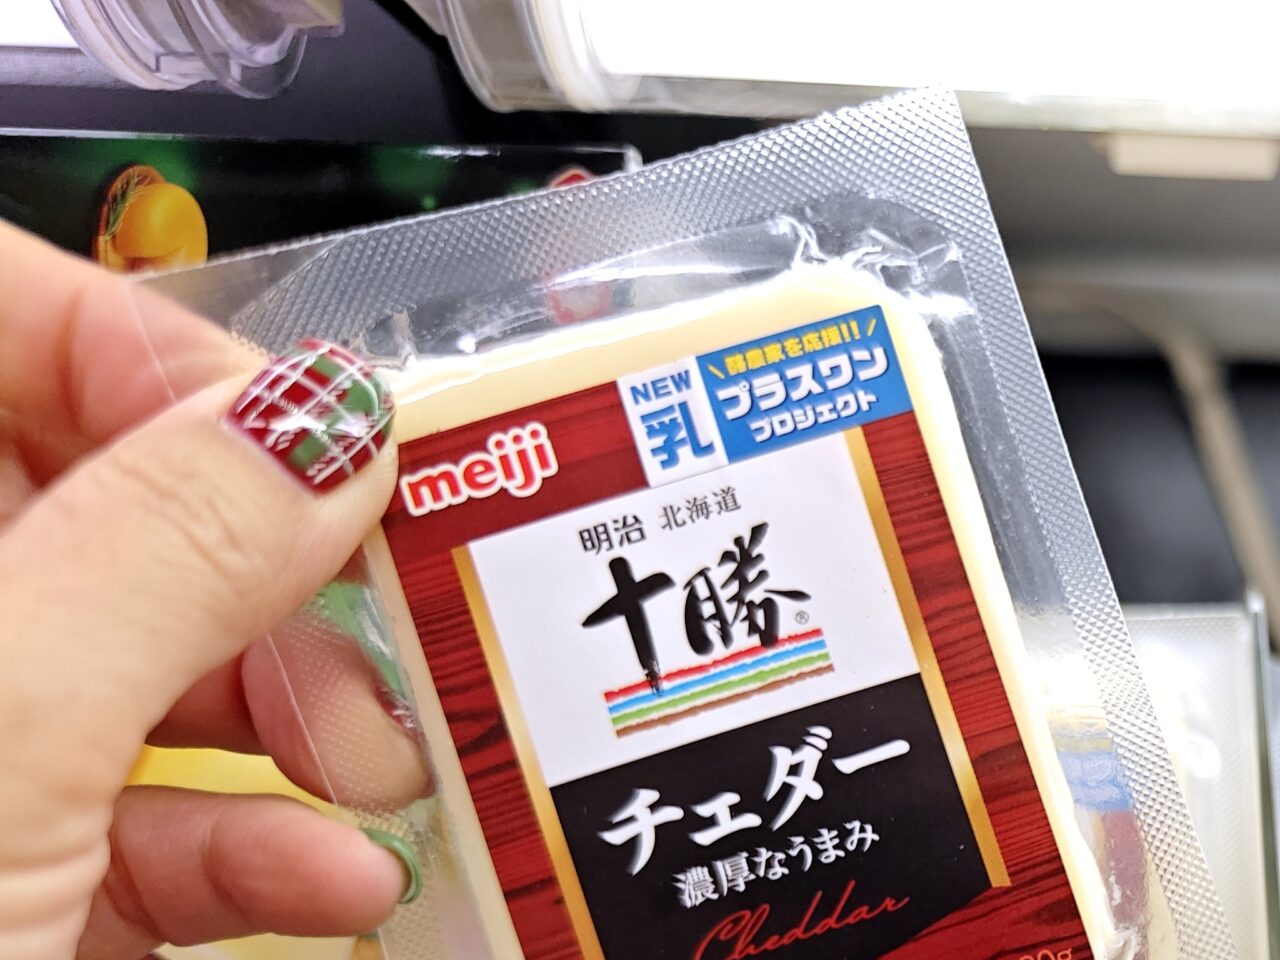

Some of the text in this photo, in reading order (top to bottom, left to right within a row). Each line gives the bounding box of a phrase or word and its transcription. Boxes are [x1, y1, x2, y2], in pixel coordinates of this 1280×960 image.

[630, 370, 692, 404] NEW
[716, 346, 889, 421] プラスワン
[750, 389, 879, 443] プロジェクト
[403, 424, 558, 514] meiji
[640, 404, 715, 470] 乳
[578, 487, 742, 556] 明治 北海道
[582, 522, 812, 697] 十勝
[599, 726, 911, 875] チェダー
[678, 819, 880, 909] 濃厚なうまみ
